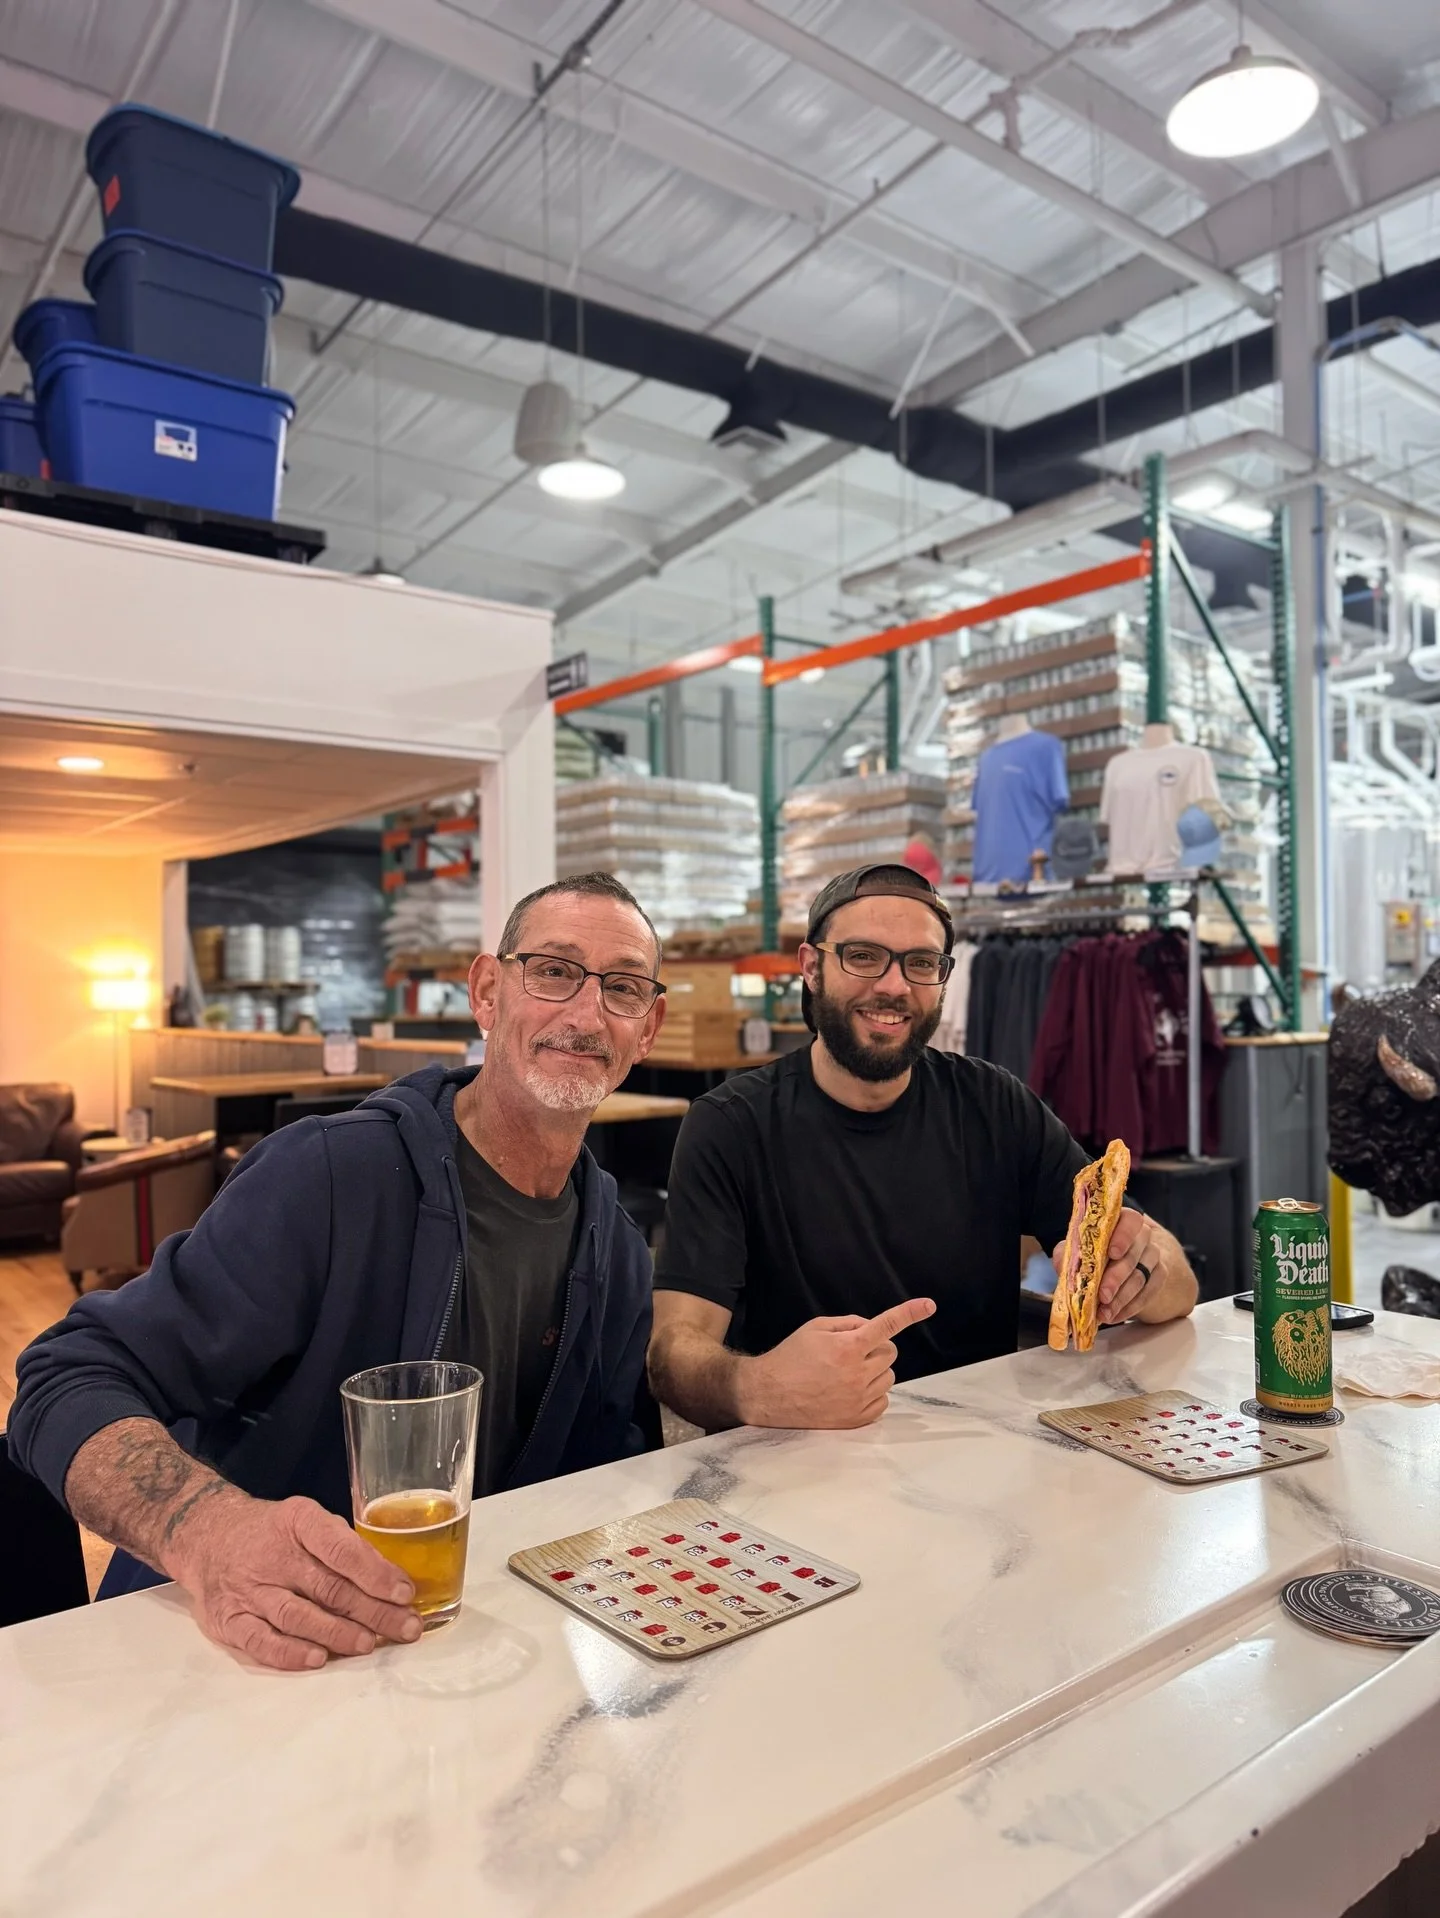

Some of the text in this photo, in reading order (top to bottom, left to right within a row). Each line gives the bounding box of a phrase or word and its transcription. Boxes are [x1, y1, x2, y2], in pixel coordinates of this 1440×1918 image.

[1270, 1234, 1328, 1267] Liquid
[1276, 1259, 1329, 1285] Death
[1275, 1288, 1314, 1296] SEVERED
[687, 1547, 704, 1557] 30
[596, 1599, 616, 1608] 75
[662, 1599, 679, 1609] 57
[723, 1597, 742, 1609] 35
[1319, 1593, 1360, 1618] COMPANY
[685, 1612, 703, 1623] 58
[1375, 1607, 1440, 1627] BUFFALO
